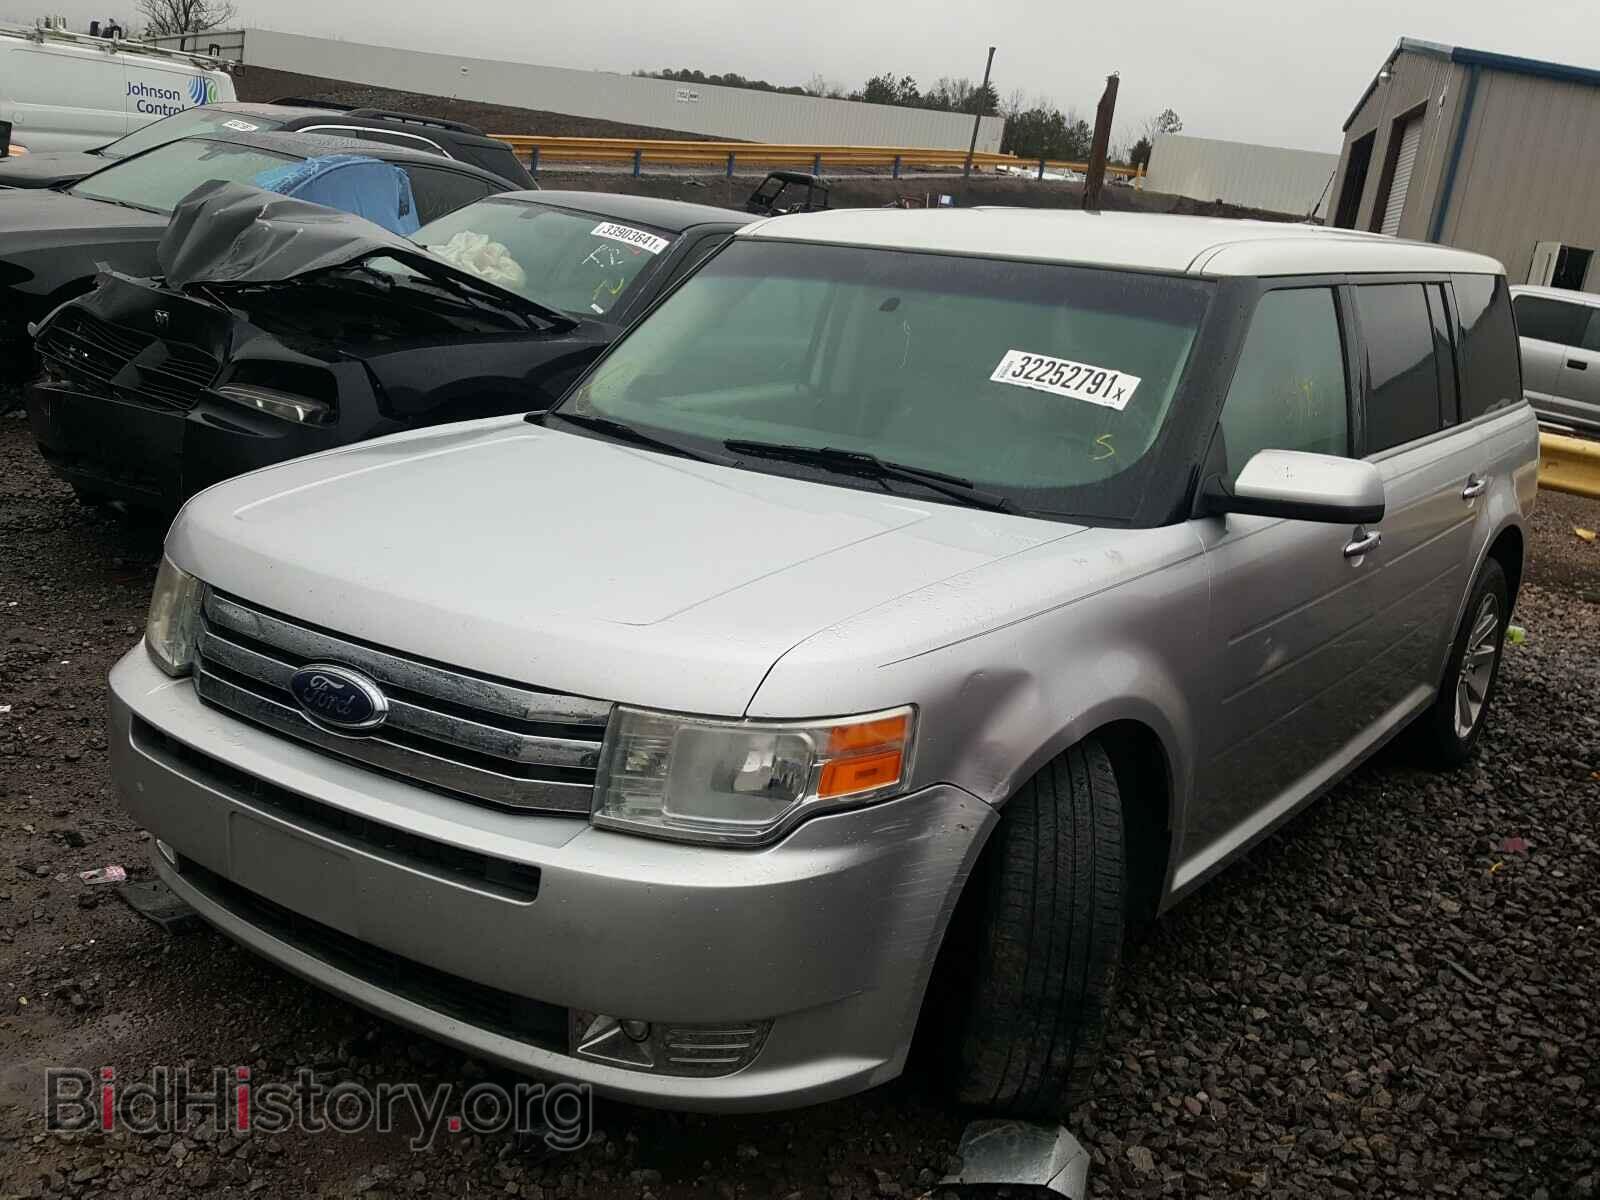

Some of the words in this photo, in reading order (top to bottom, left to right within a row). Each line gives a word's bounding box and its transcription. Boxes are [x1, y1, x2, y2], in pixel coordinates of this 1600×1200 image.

[126, 81, 181, 101] Johnson
[602, 224, 657, 248] 33903641
[1012, 355, 1119, 398] 32252791
[303, 674, 356, 715] Ford
